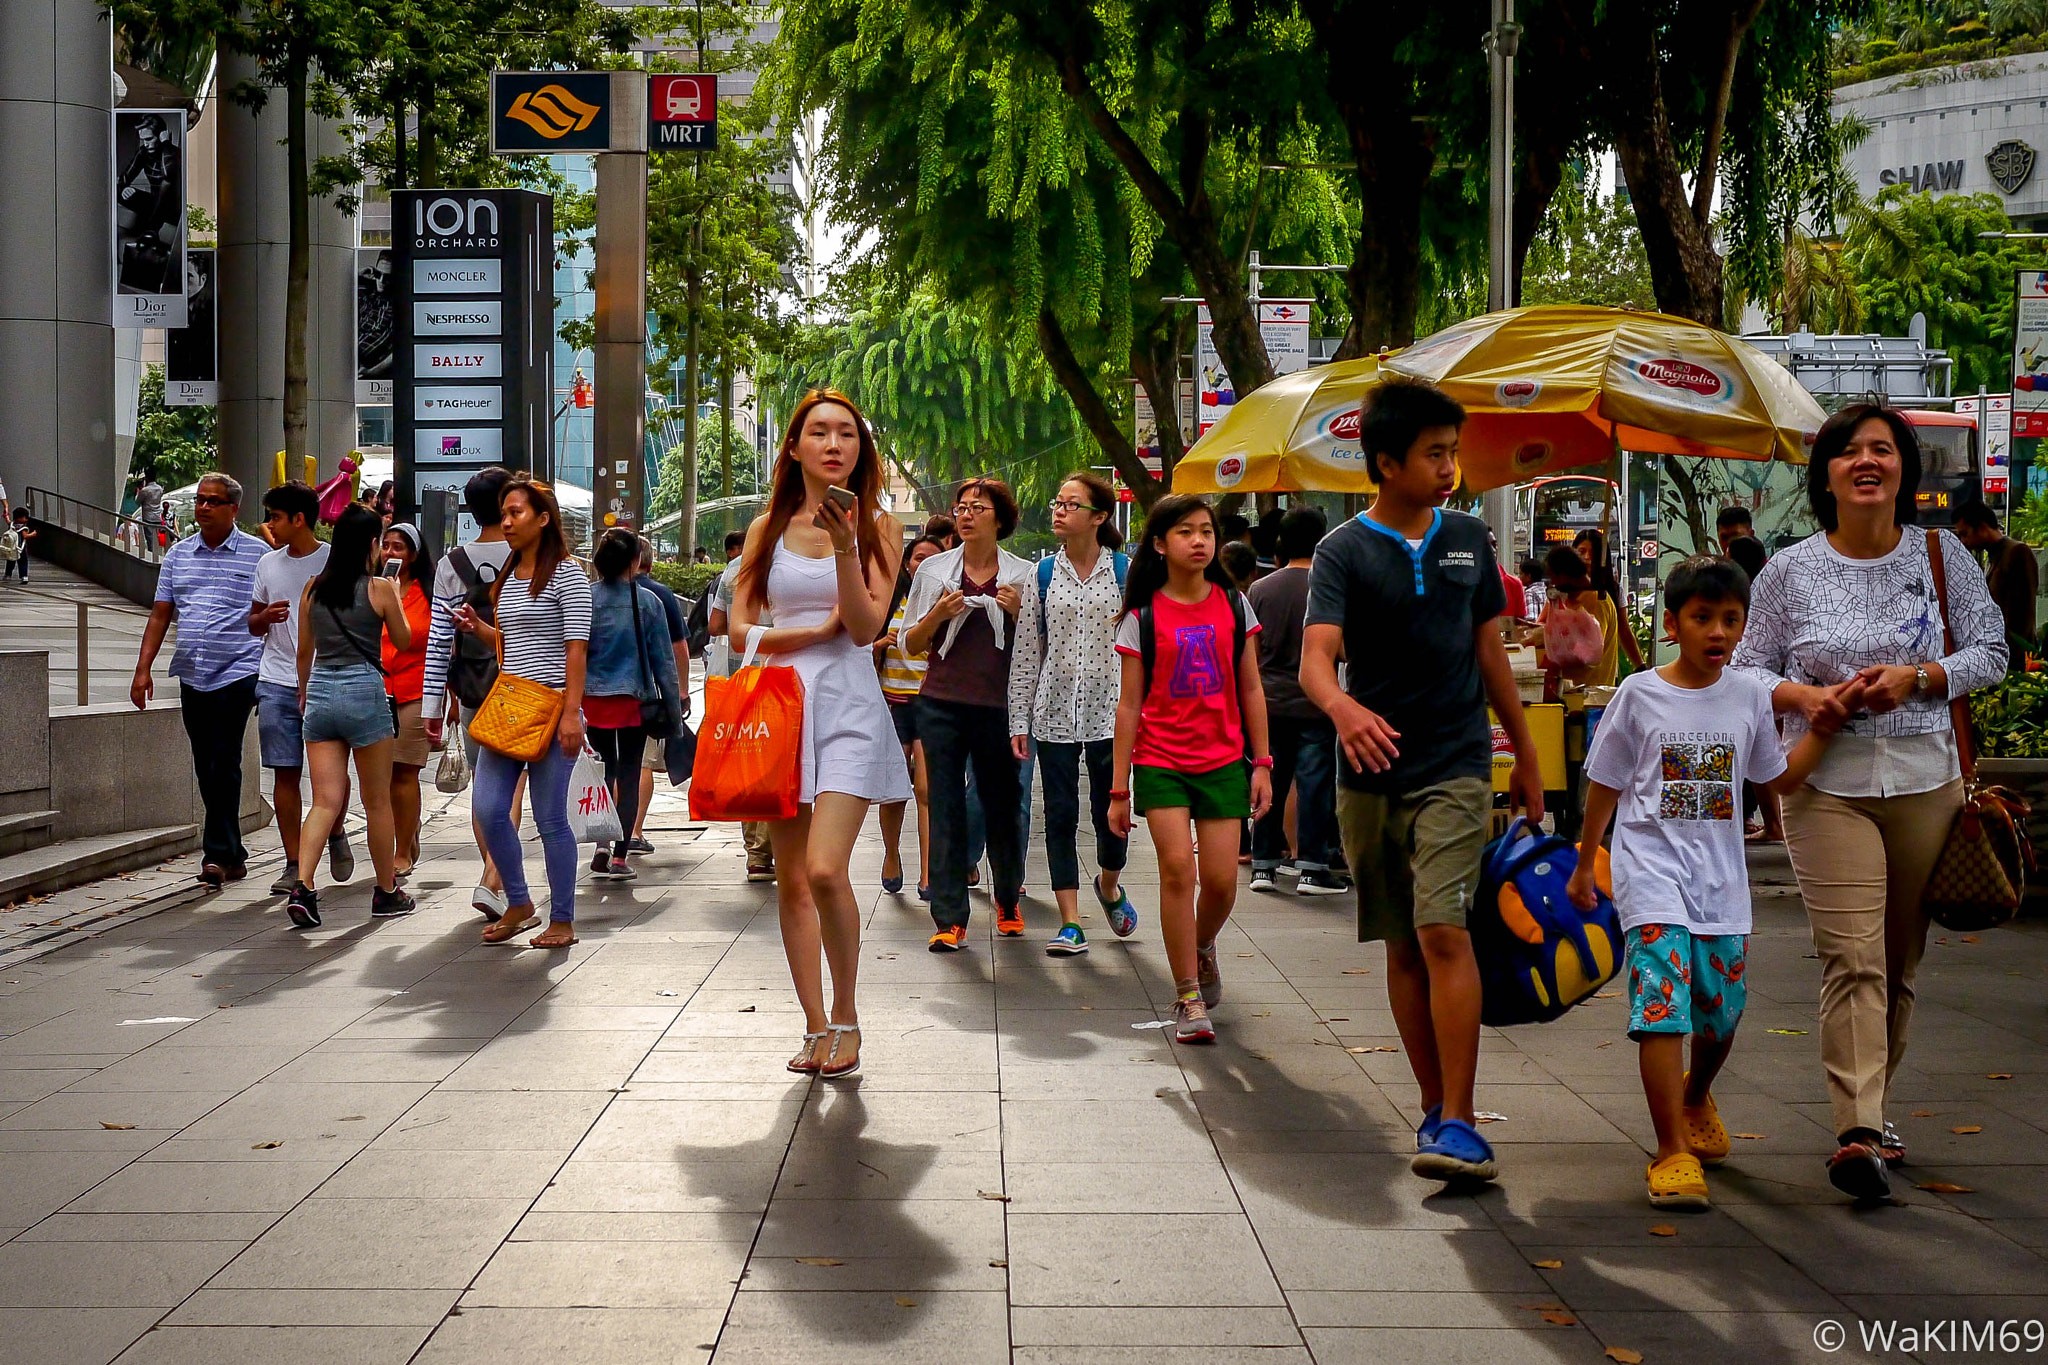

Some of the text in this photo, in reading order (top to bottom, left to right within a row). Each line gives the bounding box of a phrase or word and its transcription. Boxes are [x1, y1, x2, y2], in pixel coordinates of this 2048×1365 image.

[661, 124, 705, 142] MRT
[1993, 152, 2025, 178] SB
[1879, 159, 1963, 193] SHAW
[415, 238, 499, 248] ORCHARD
[427, 272, 487, 281] MONCLER
[134, 297, 166, 312] Dior
[424, 312, 491, 325] NESPRESSO
[431, 356, 485, 367] BALLY
[1642, 362, 1717, 386] Magnolia
[180, 382, 203, 394] Dior
[1331, 446, 1352, 459] ice
[1937, 493, 1948, 507] 14
[1169, 624, 1224, 698] A
[1659, 732, 1735, 742] BARCELONA
[578, 785, 610, 816] H&M
